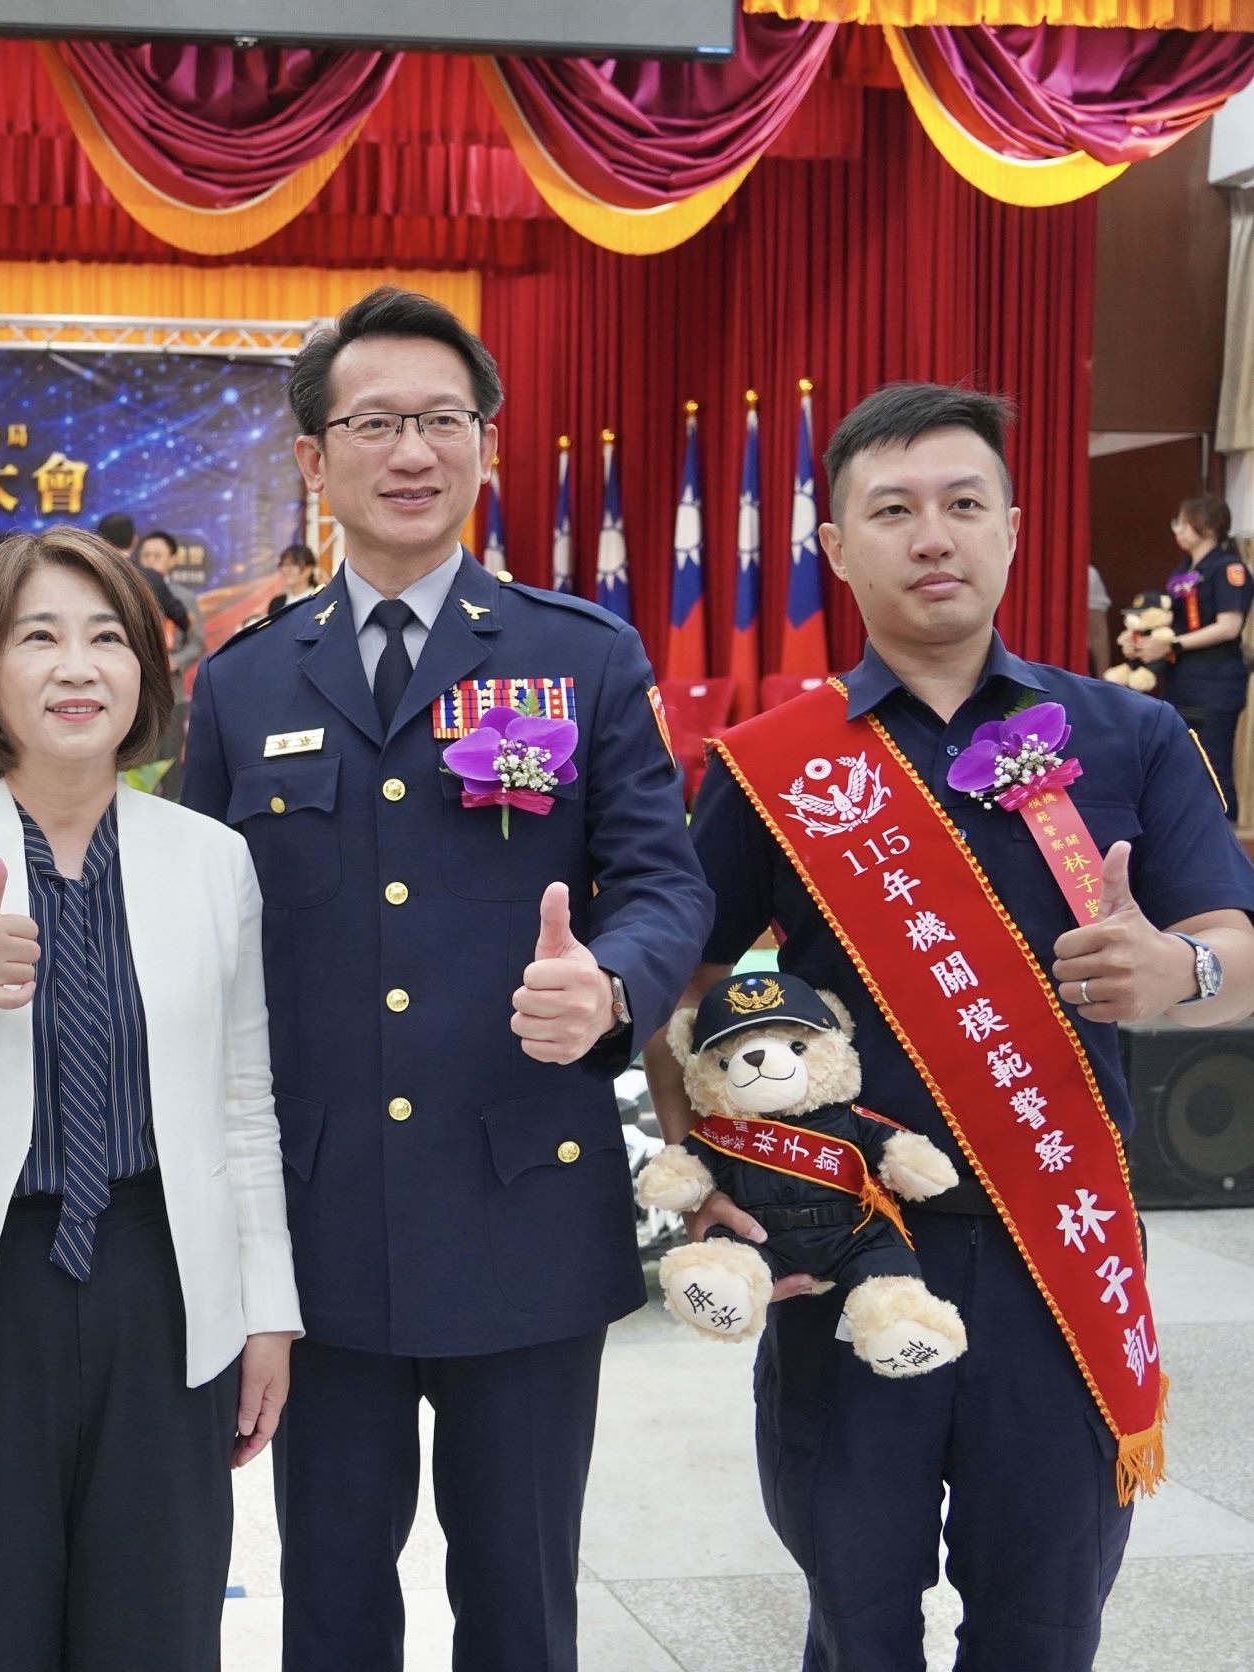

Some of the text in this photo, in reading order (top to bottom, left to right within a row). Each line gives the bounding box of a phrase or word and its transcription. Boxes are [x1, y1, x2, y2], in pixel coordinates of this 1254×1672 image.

[752, 1127, 844, 1176] 林子凱
[683, 1282, 742, 1330] 屏安
[1056, 1188, 1159, 1387] 林子凱
